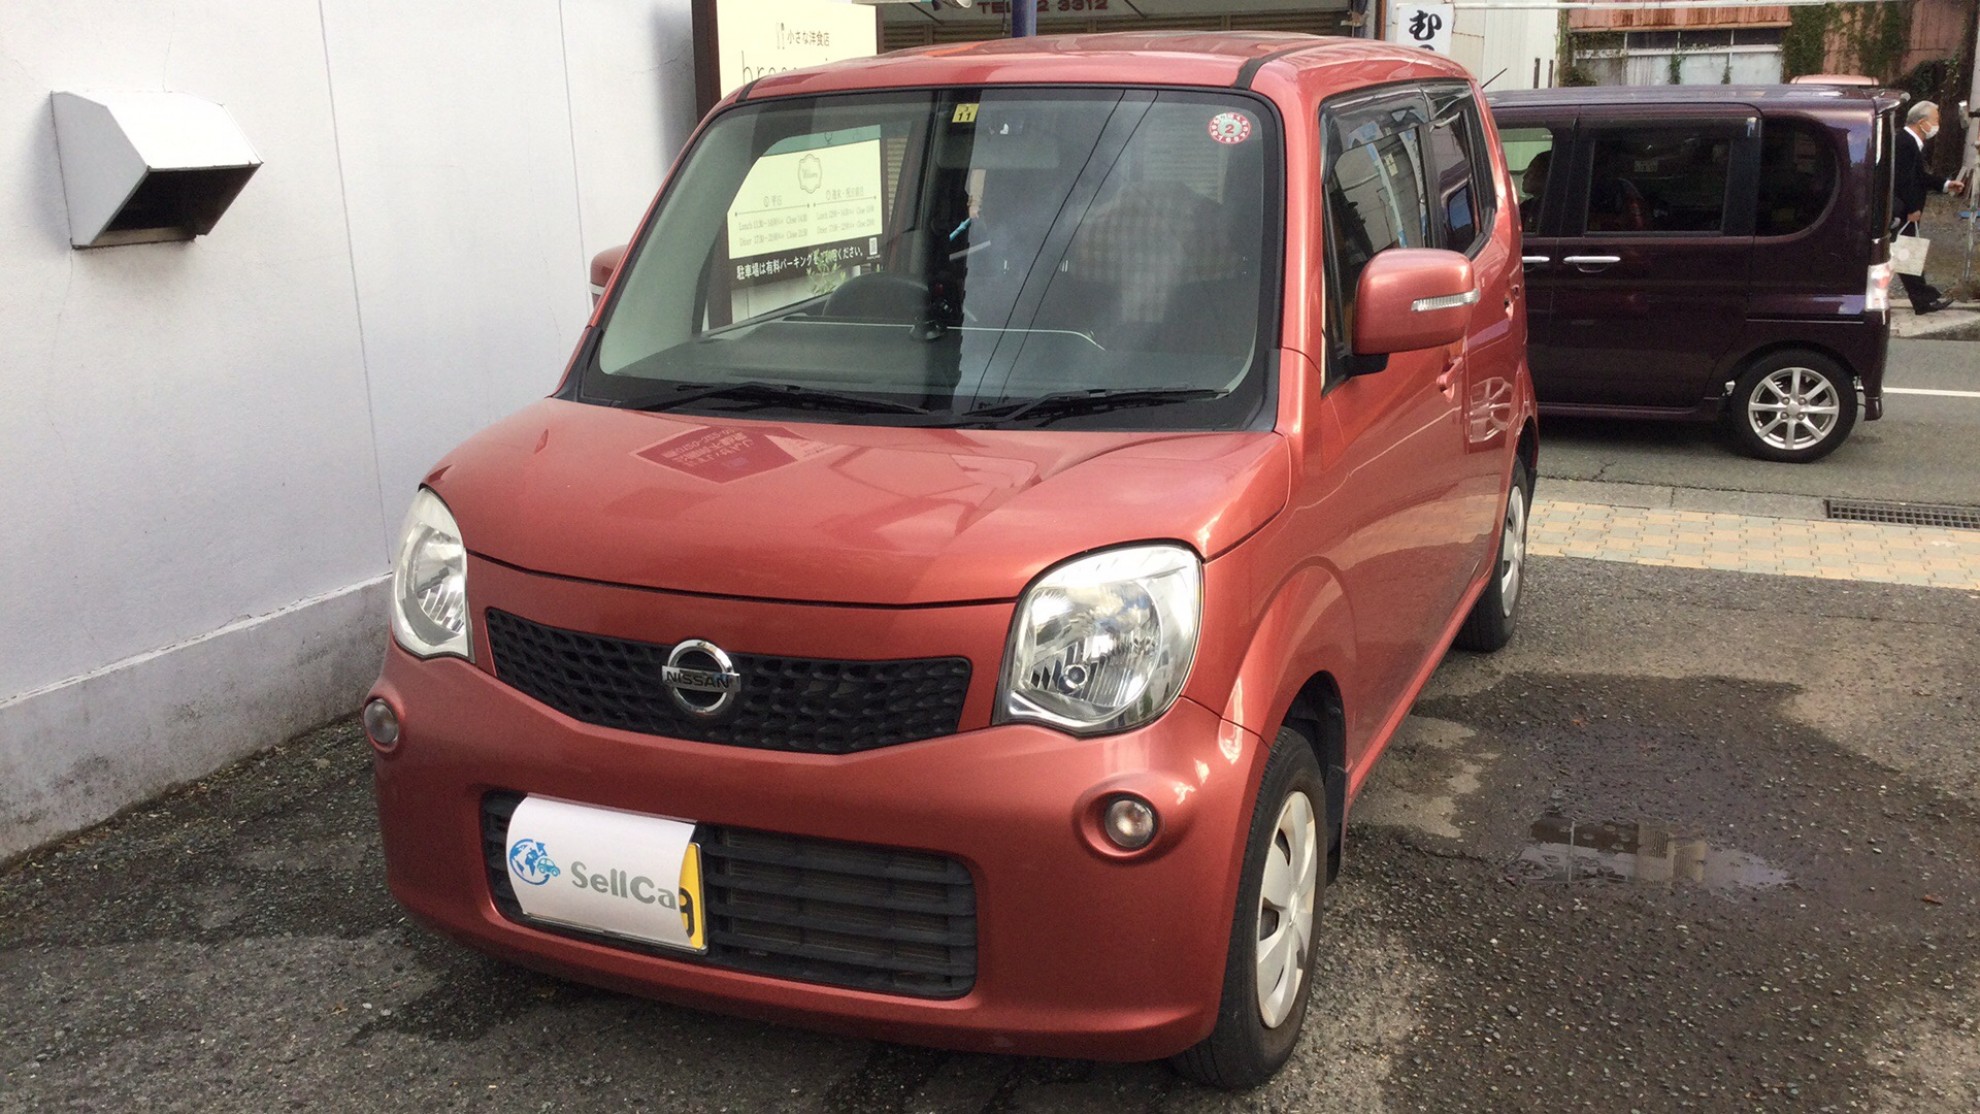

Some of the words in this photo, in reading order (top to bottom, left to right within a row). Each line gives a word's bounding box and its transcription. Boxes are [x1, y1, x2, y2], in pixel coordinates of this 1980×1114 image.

[787, 29, 830, 48] 小さな洋食店
[1408, 9, 1443, 51] む
[958, 112, 972, 121] 11
[1224, 123, 1235, 134] 2
[665, 670, 730, 689] NISSAN
